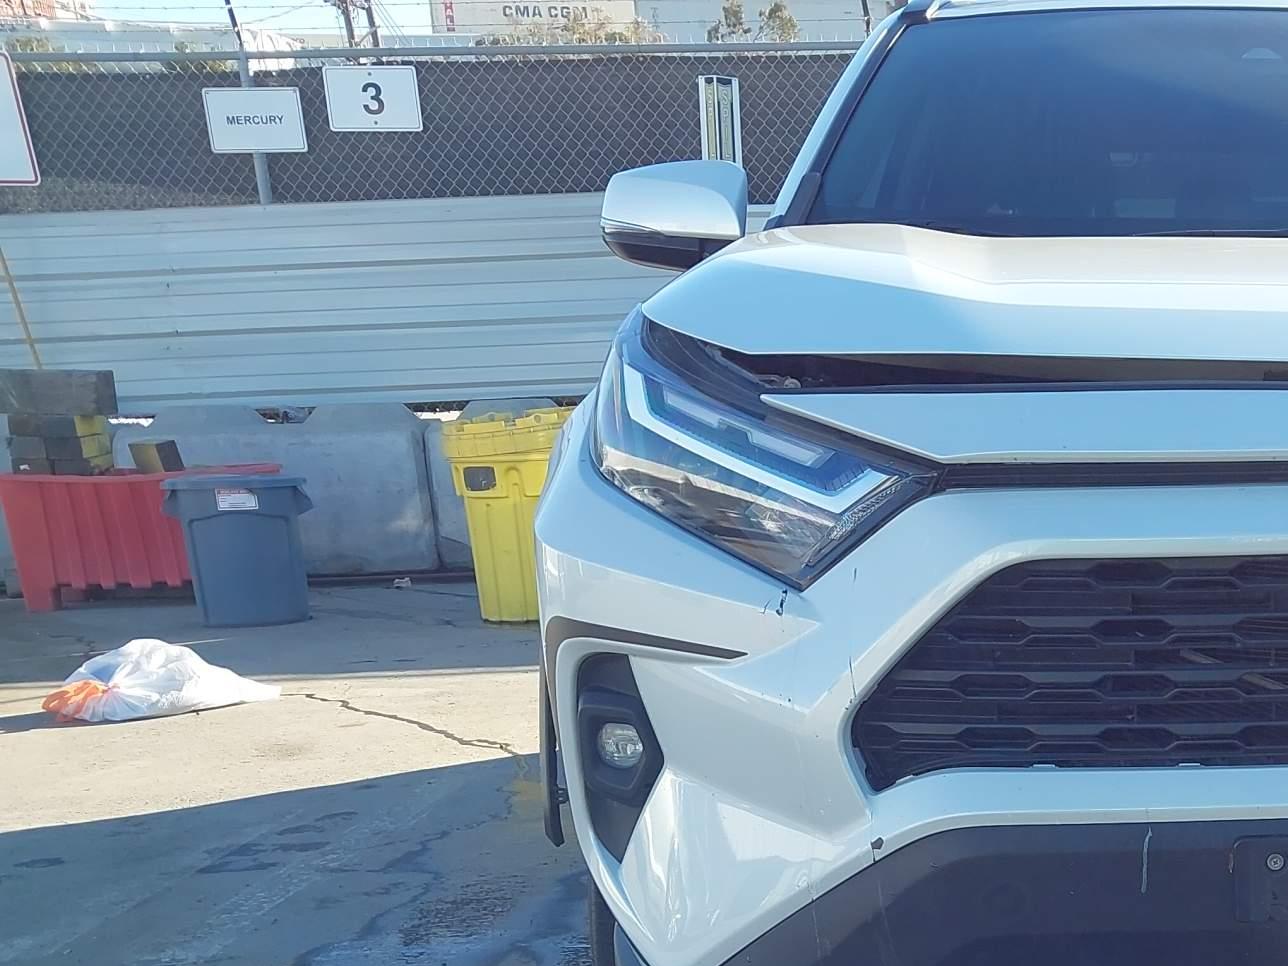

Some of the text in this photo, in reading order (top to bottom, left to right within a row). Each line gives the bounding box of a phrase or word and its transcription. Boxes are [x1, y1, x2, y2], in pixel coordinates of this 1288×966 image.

[502, 5, 588, 19] CMA CGM
[361, 82, 385, 115] 3
[226, 115, 285, 126] MERCURY
